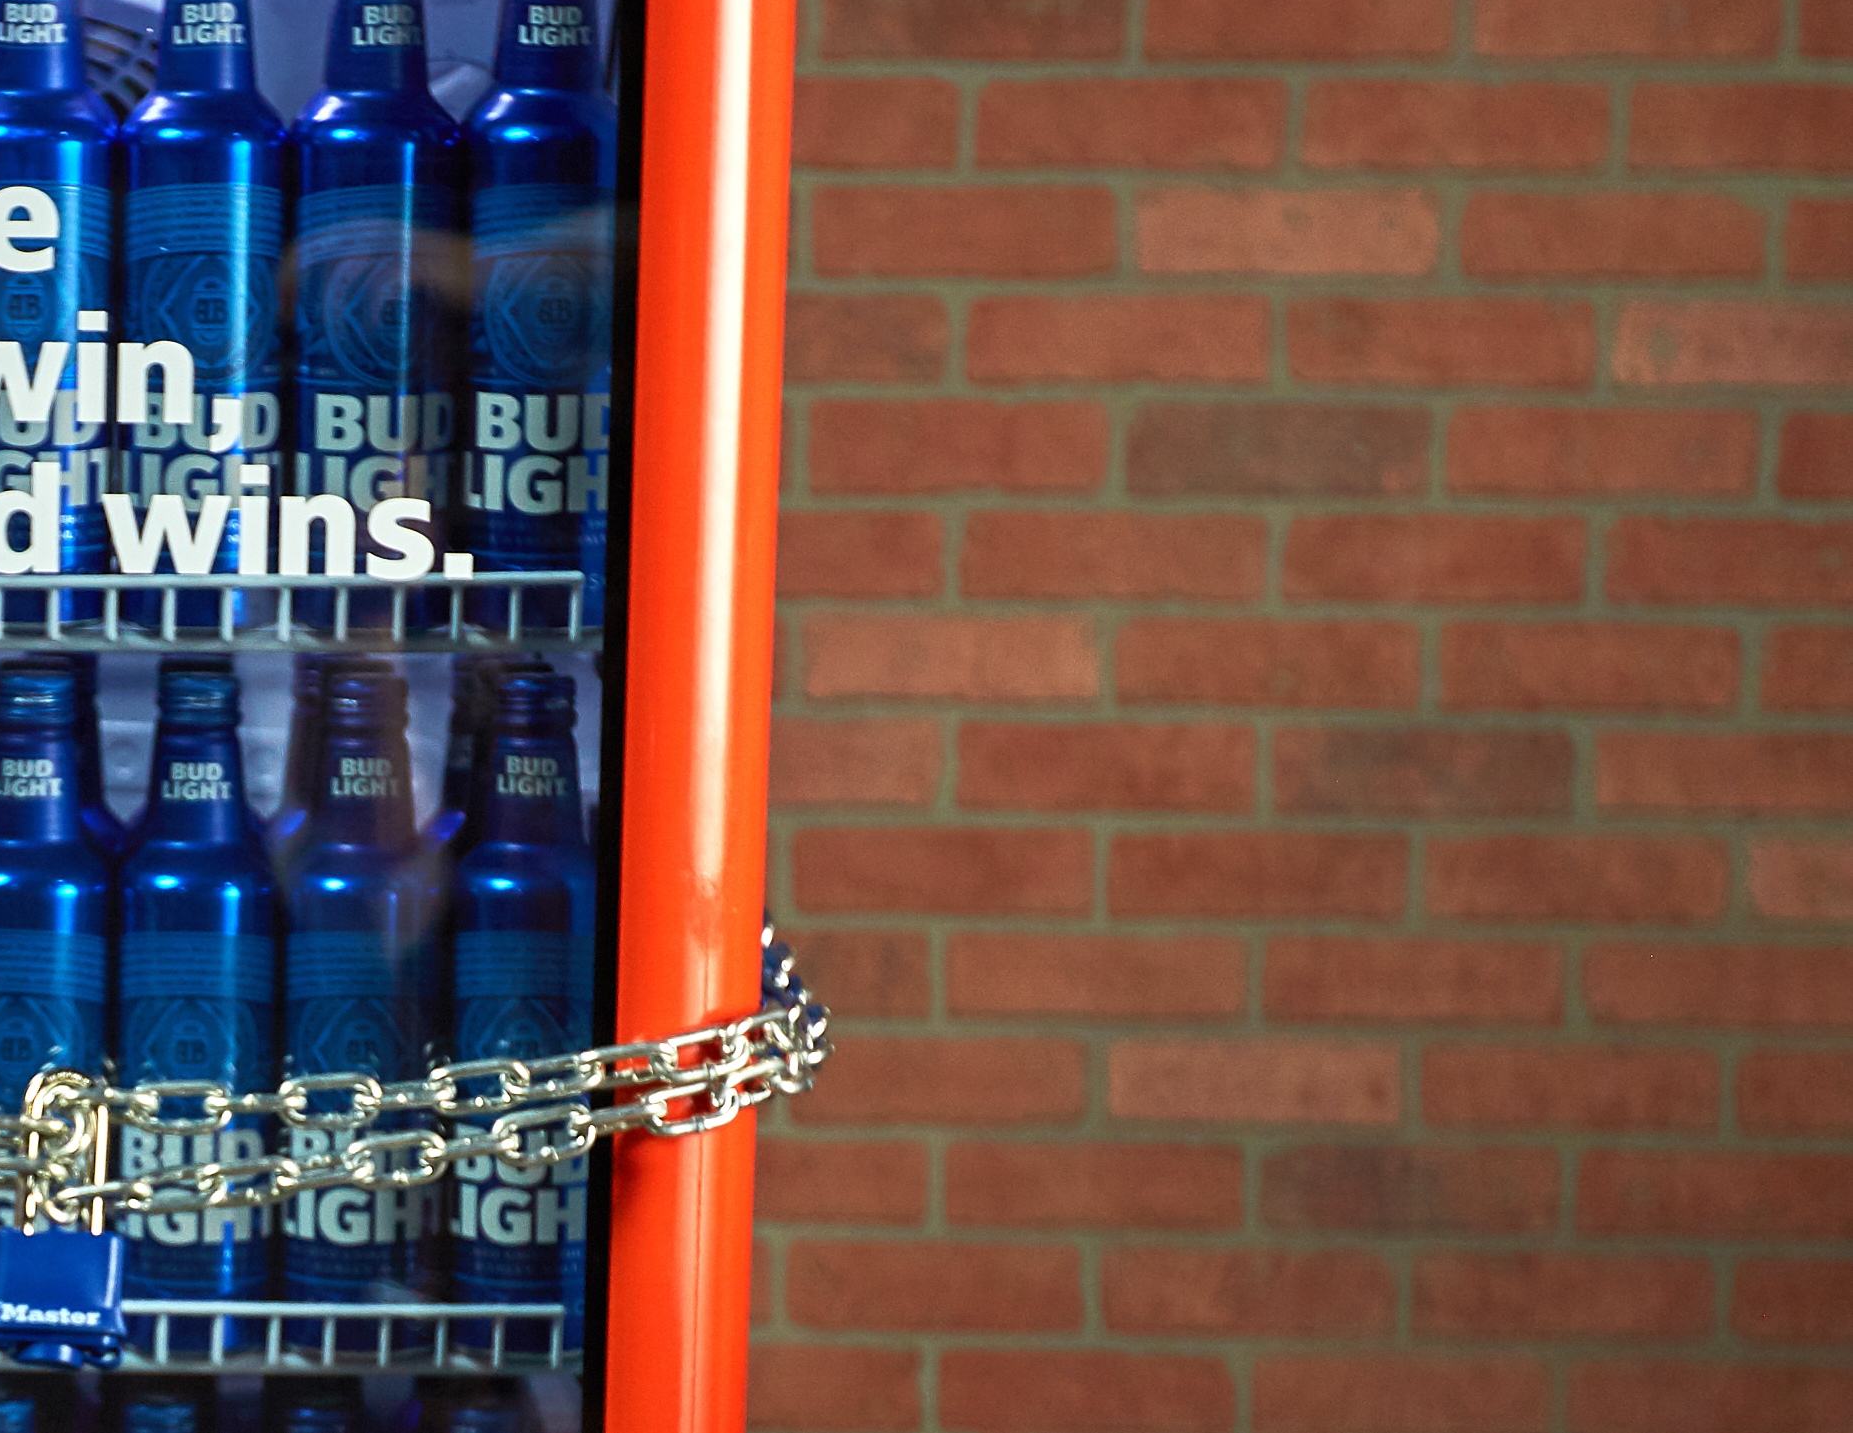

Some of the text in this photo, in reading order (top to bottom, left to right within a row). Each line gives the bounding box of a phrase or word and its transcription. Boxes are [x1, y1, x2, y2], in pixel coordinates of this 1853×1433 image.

[4, 2, 58, 23] BUD
[181, 2, 237, 23] BUD
[362, 5, 416, 25] BUD
[528, 5, 583, 25] BUD
[172, 23, 246, 45] LIGHT
[352, 25, 424, 46] LIGHT
[518, 24, 592, 46] LIGHT
[463, 451, 610, 514] LIGH
[102, 464, 474, 582] wins.
[2, 759, 54, 777] BUD
[171, 762, 224, 781] BUD
[340, 757, 393, 776] BUD
[506, 755, 559, 775] BUD
[162, 780, 232, 800] LIGHT
[330, 776, 403, 797] LIGHT
[497, 774, 568, 797] LIGHT
[0, 1302, 102, 1327] Master
